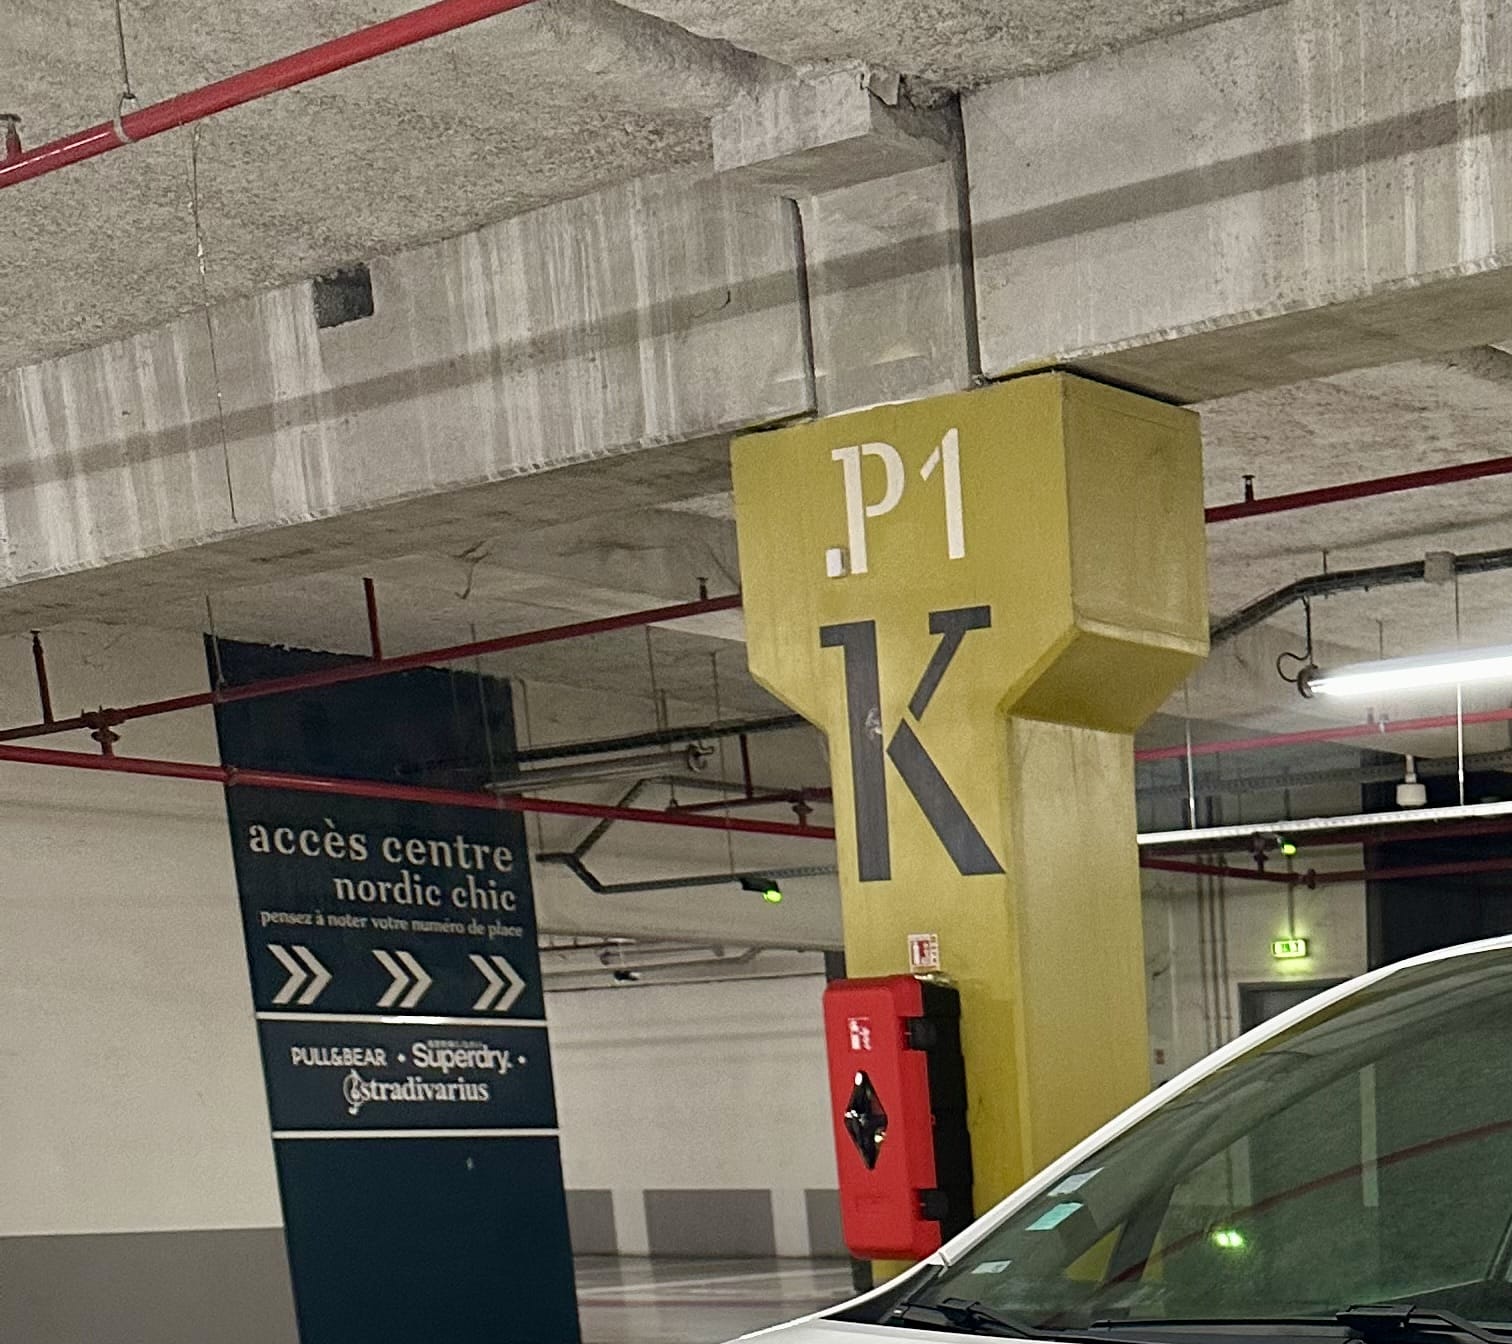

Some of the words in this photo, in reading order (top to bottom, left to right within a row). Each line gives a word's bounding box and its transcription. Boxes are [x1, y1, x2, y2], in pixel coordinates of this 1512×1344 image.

[831, 428, 966, 574] P1
[819, 604, 1007, 883] K
[249, 818, 368, 861] accès
[381, 834, 514, 872] centre
[333, 869, 442, 906] nordic
[451, 874, 517, 912] chic
[259, 909, 313, 927] pensez
[315, 909, 325, 926] à
[327, 914, 369, 928] noter
[371, 916, 409, 931] votre
[411, 917, 465, 934] numéro
[467, 918, 486, 936] de
[487, 922, 524, 940] place
[290, 1046, 388, 1067] PULL&BEAR
